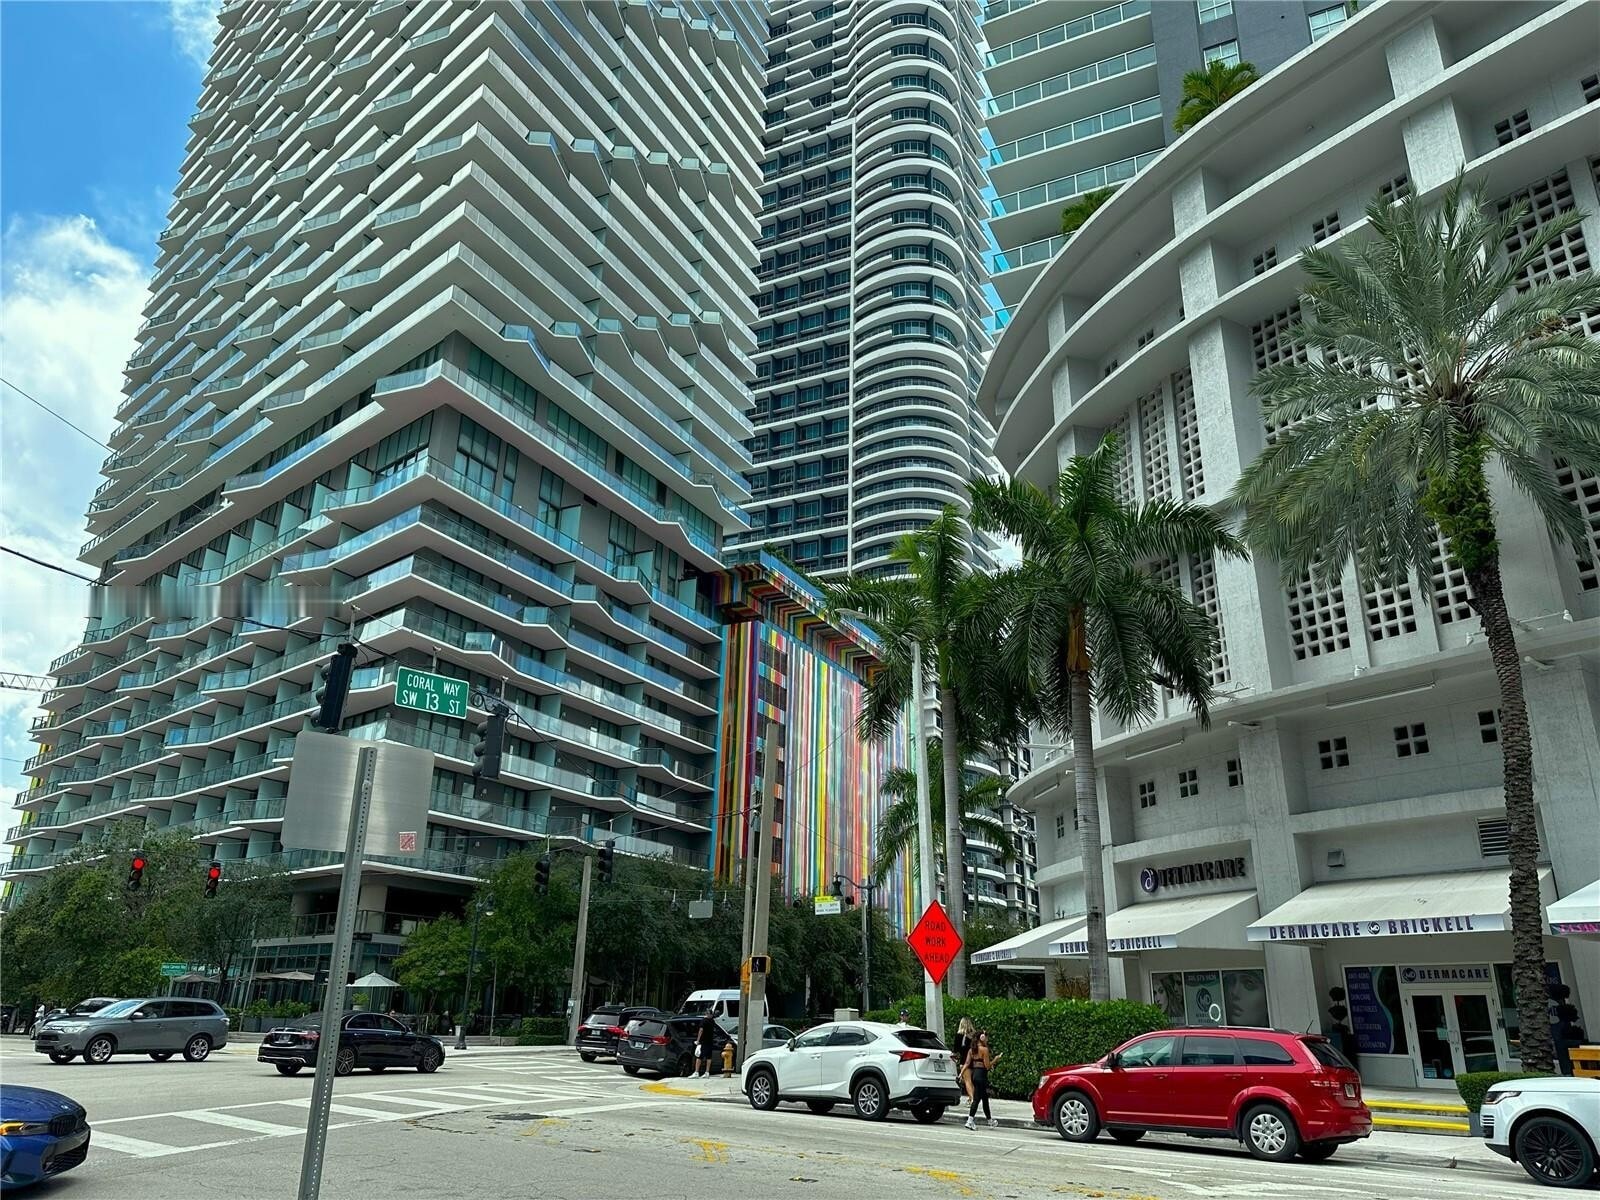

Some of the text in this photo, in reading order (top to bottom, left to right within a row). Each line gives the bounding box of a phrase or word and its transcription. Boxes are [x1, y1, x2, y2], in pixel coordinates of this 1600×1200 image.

[407, 674, 461, 696] CORAL WAY
[402, 690, 461, 715] SW 13 ST
[1158, 858, 1245, 886] DERMACARE
[925, 921, 946, 931] ROAD
[1269, 922, 1360, 939] DERMACARE
[1388, 916, 1474, 934] BRICKELL
[925, 936, 946, 947] WORK
[1060, 936, 1162, 954] DERMA BRICKELL
[924, 952, 950, 963] AHEAD
[1419, 968, 1489, 979] DERMACARE
